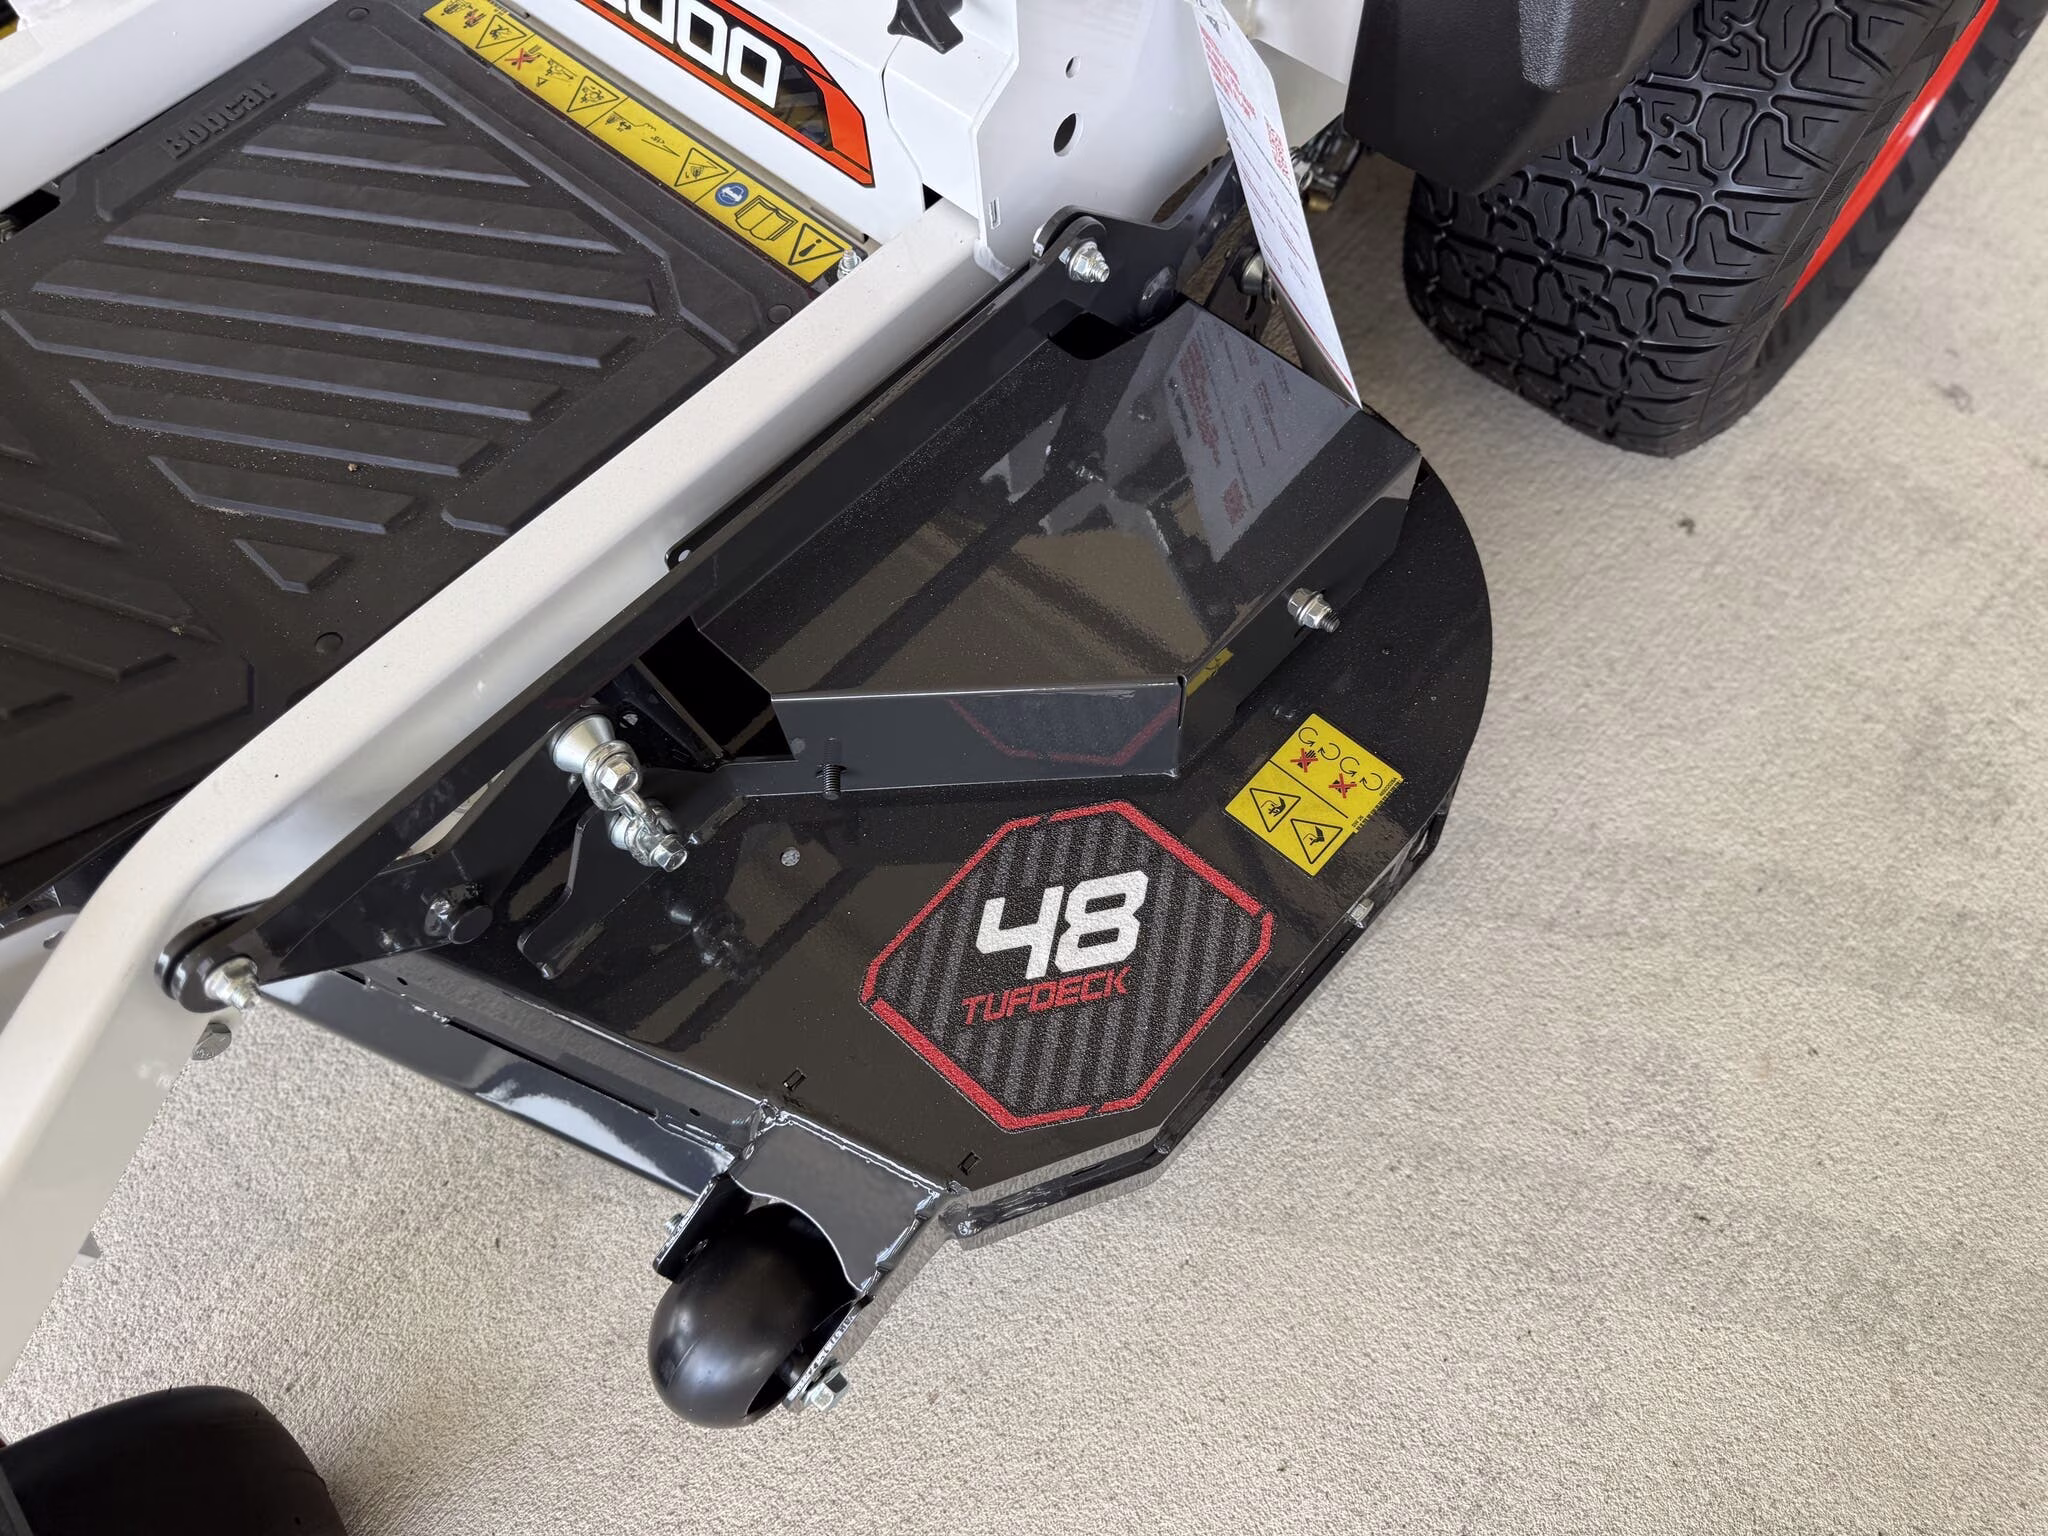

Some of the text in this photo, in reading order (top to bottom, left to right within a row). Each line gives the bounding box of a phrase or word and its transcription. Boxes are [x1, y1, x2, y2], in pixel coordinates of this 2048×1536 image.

[604, 0, 782, 108] 000
[975, 870, 1149, 980] 48
[961, 967, 1129, 1025] TUFDECK
